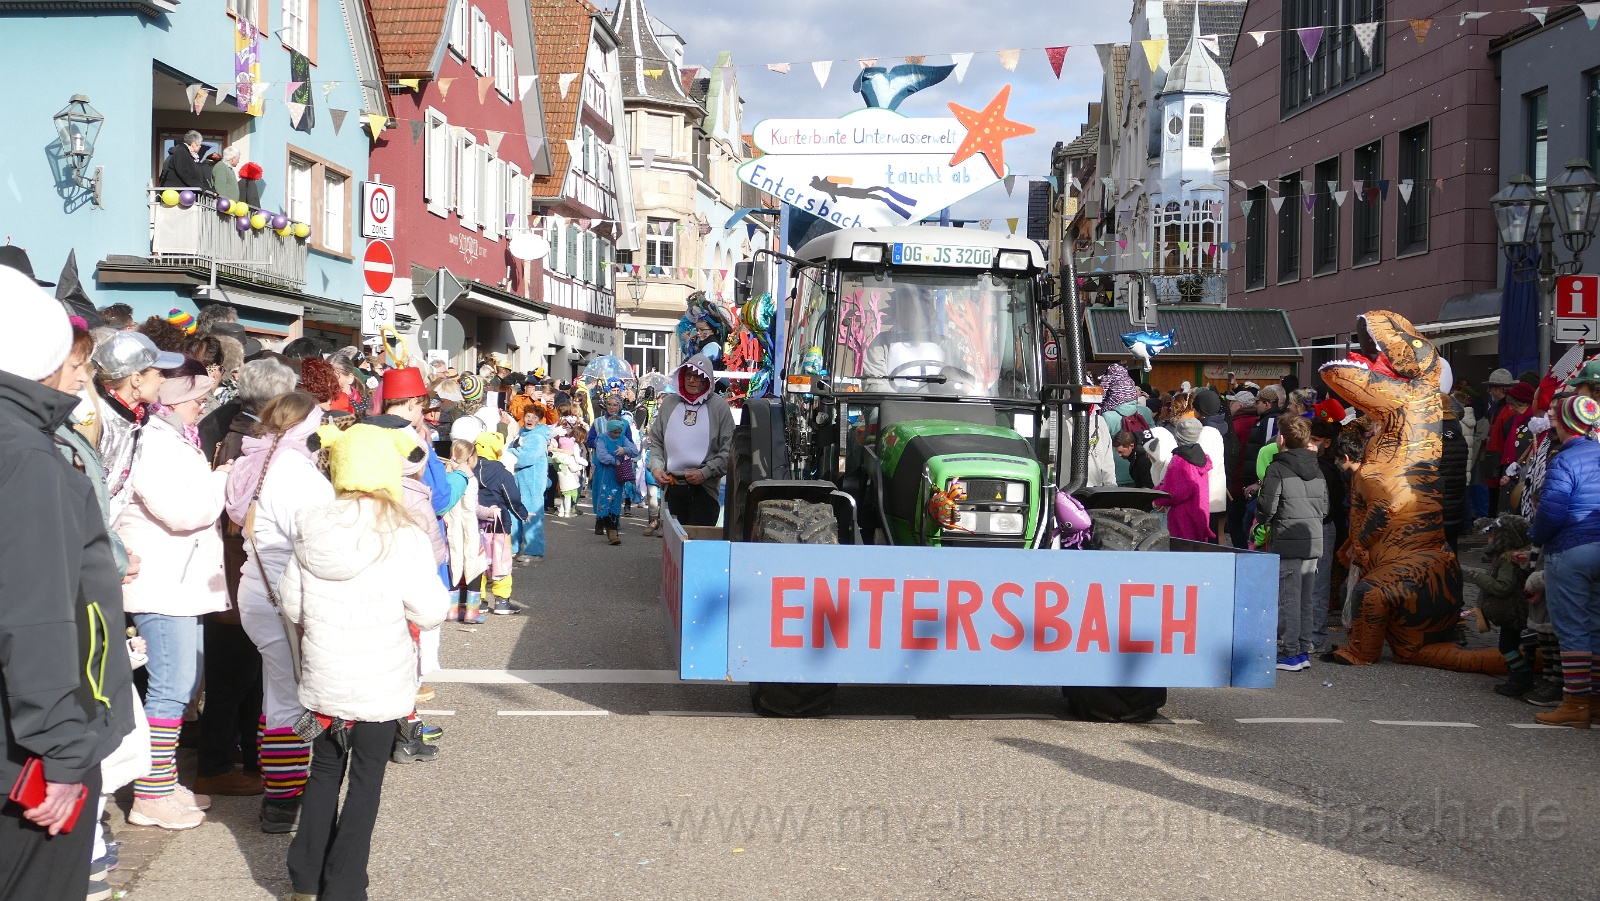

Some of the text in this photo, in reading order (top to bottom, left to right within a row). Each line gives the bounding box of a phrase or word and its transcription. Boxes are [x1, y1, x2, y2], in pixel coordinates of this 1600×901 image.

[771, 127, 957, 145] Kunterbunte Unterwasserwelt
[885, 164, 971, 185] taucht ab
[374, 197, 385, 214] 10
[749, 164, 862, 228] Entersbach
[371, 224, 388, 236] ZONE
[903, 245, 992, 265] OG JS 3200
[1211, 363, 1284, 376] Brch-Schenke
[770, 576, 1199, 655] ENTERSBACH
